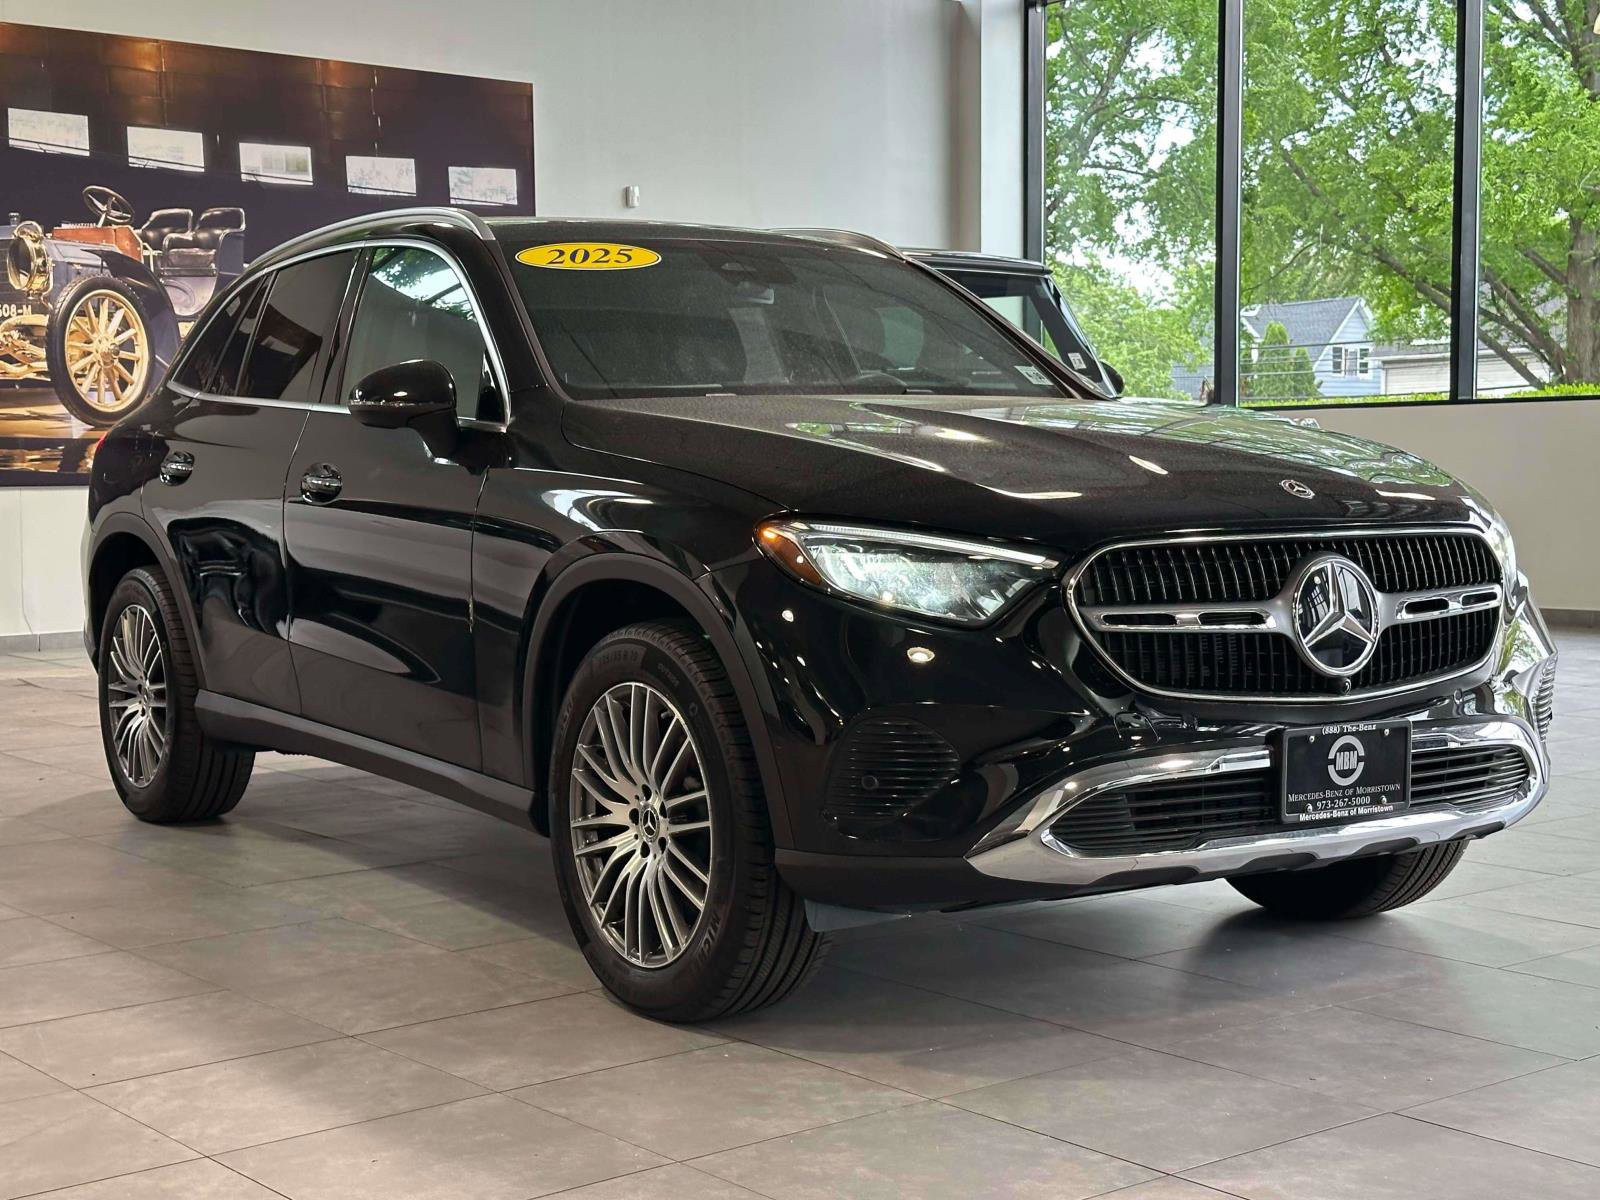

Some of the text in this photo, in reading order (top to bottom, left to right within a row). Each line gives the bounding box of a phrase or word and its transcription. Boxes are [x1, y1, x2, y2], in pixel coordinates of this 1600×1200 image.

[547, 248, 633, 264] 2025
[1322, 723, 1376, 735] (888) The-Benz
[1336, 750, 1358, 770] MBM
[1288, 789, 1342, 802] MERCEDES-BENZ
[1356, 783, 1401, 794] MORRISTOWN
[1316, 795, 1370, 810] 973-267-5000
[1300, 805, 1394, 821] Mercedes-Benz of Morristown
